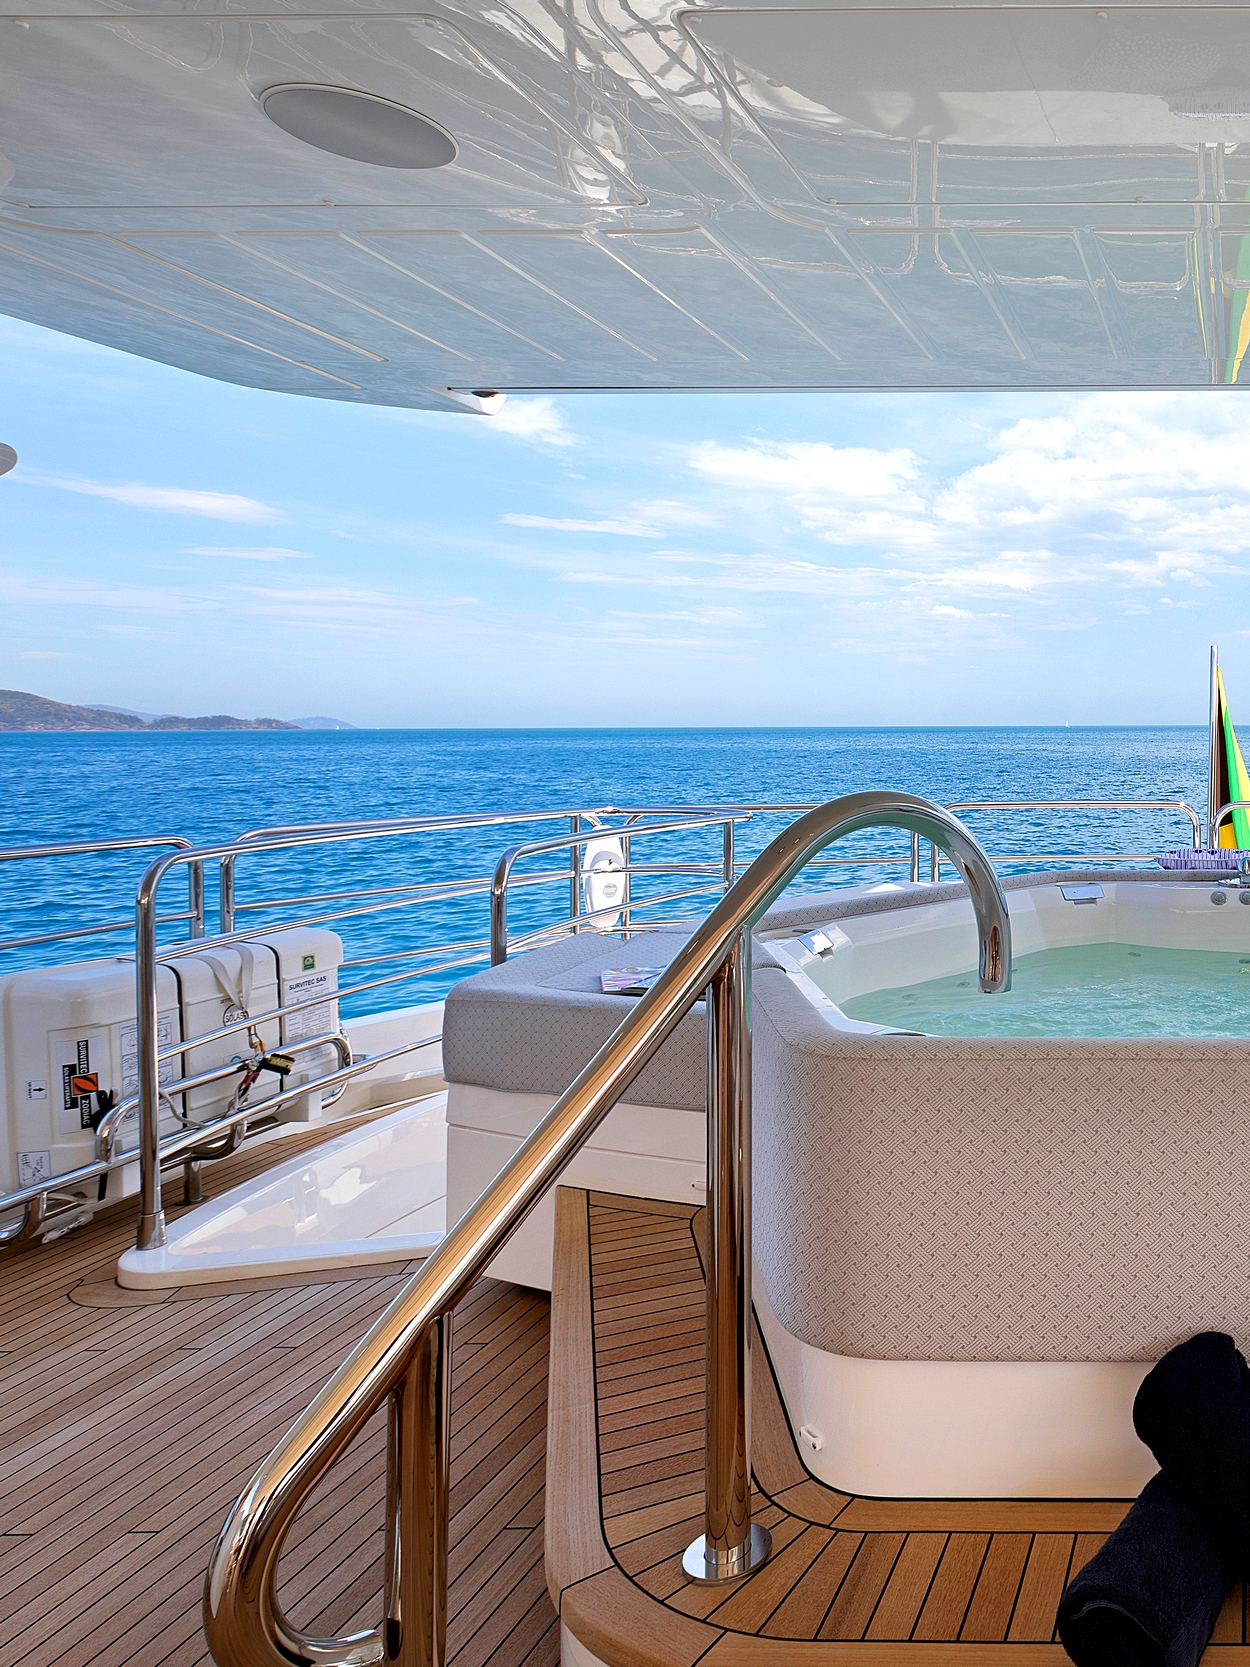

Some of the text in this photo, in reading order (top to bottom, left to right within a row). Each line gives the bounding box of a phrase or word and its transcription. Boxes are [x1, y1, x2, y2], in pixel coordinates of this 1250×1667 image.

[289, 978, 315, 991] SURVITEC
[316, 975, 327, 984] SAS
[225, 1011, 245, 1023] SOLAS
[79, 1041, 88, 1074] SURVITEC
[82, 1099, 90, 1125] ZODIAC
